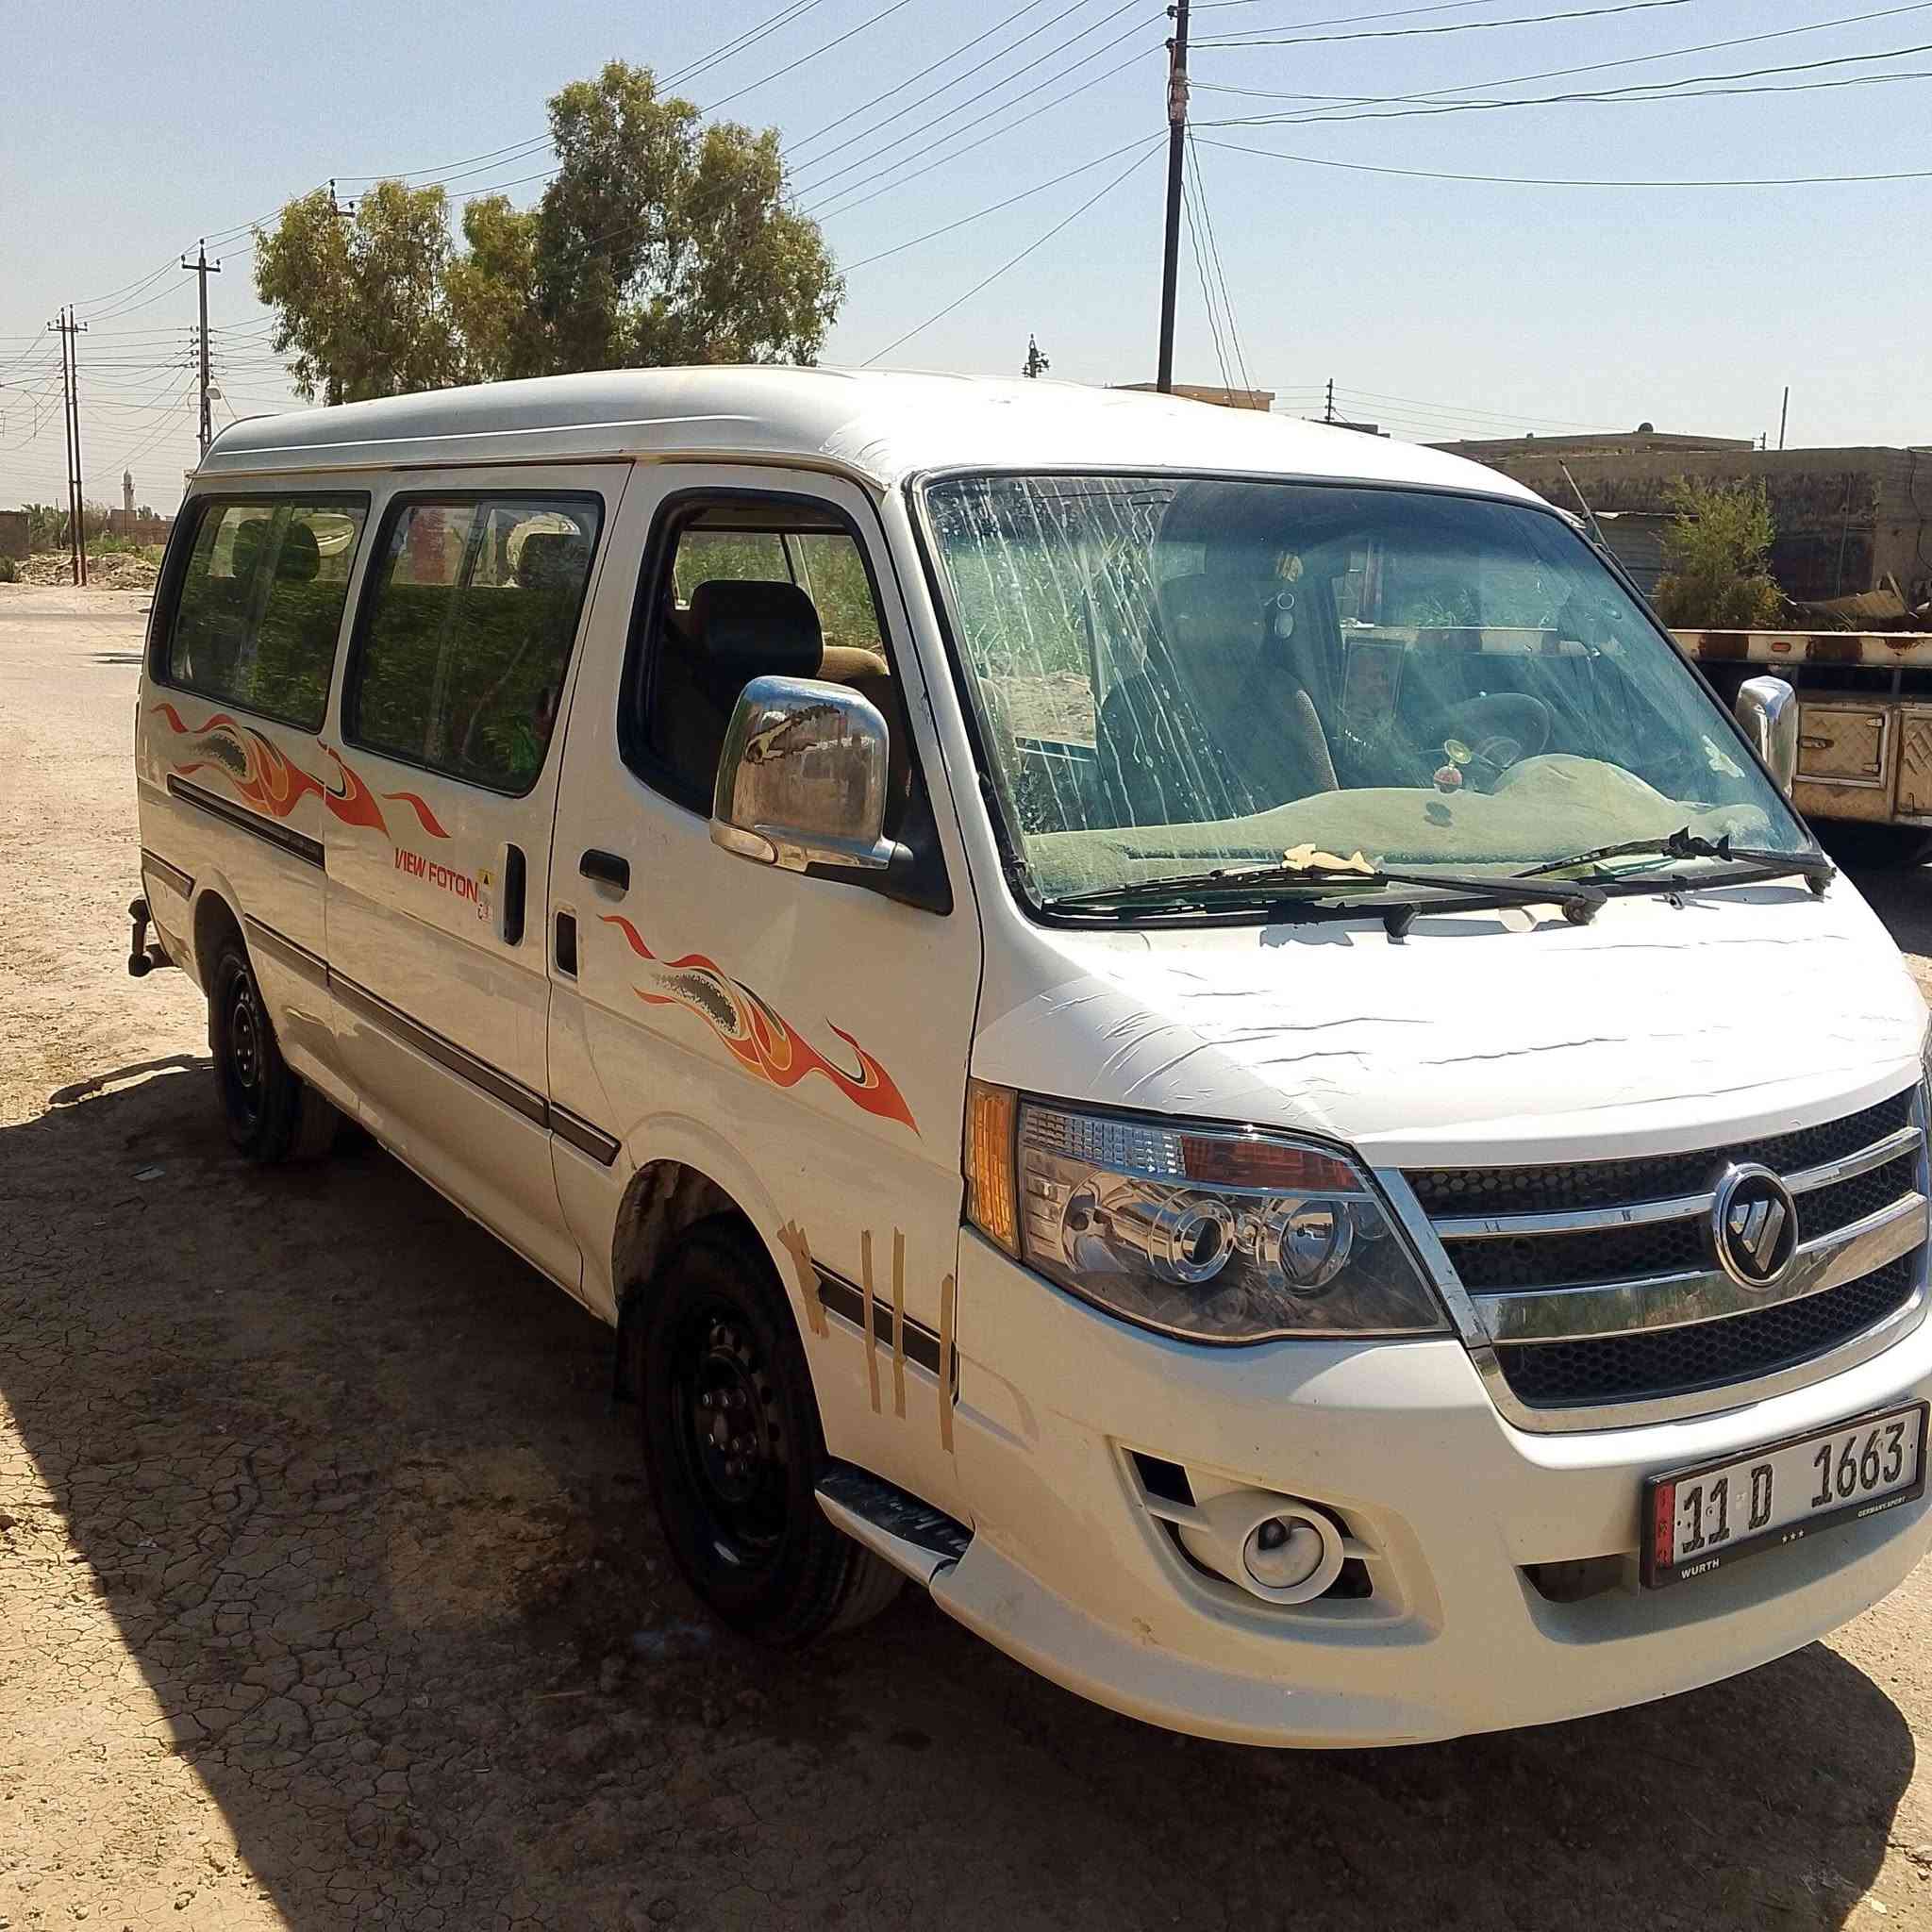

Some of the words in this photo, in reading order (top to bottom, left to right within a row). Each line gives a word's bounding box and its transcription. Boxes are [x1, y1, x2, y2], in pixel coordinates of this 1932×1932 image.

[394, 847, 426, 879] VIEW
[428, 862, 478, 904] FOTON
[1682, 1477, 1730, 1555] 11
[1748, 1463, 1774, 1531] D
[1811, 1422, 1906, 1508] 1663
[1681, 1558, 1720, 1579] WURTH
